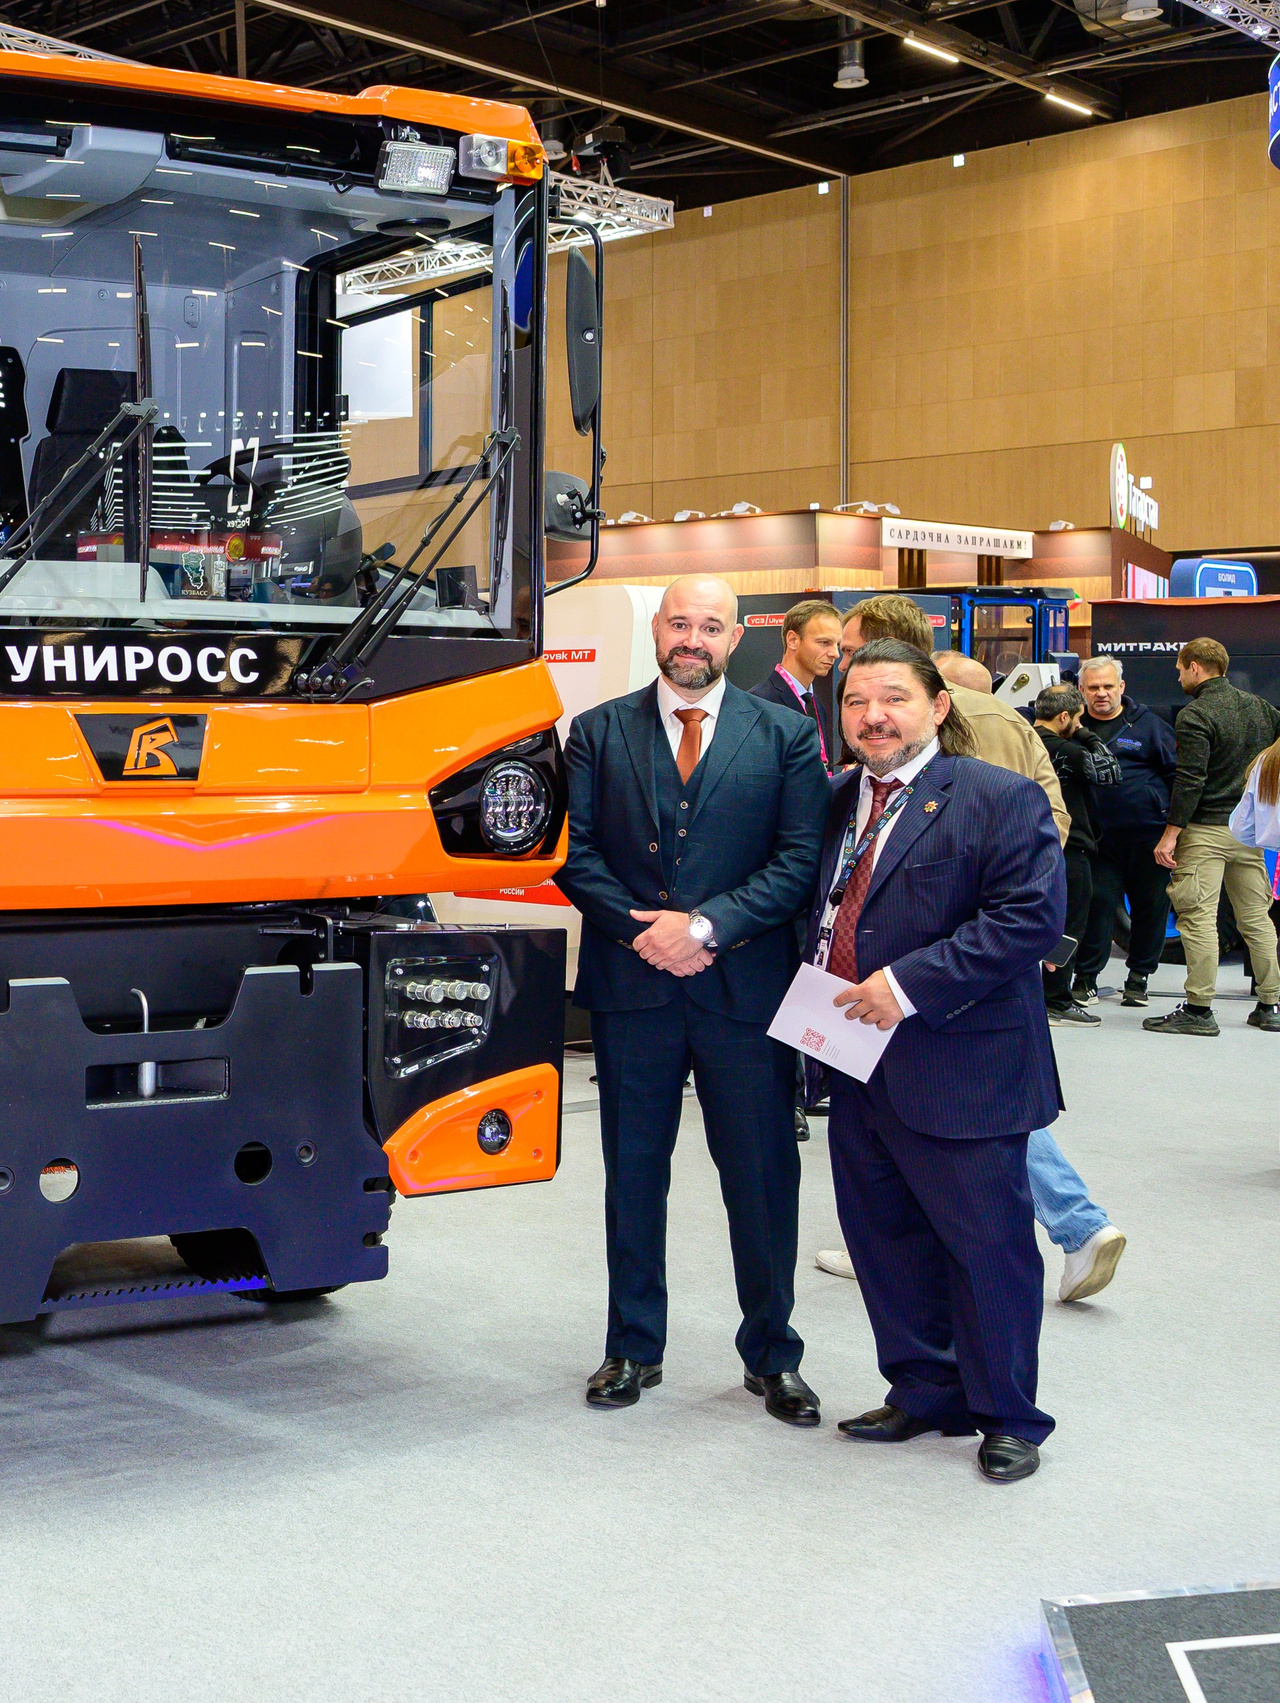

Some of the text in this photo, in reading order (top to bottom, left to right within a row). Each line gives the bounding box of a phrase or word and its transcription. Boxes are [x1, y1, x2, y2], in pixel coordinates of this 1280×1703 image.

[889, 528, 1027, 550] САРДЭЧНА ЗАПРАШАЕМ!
[5, 645, 260, 683] УНИРОСС
[570, 650, 591, 660] MT
